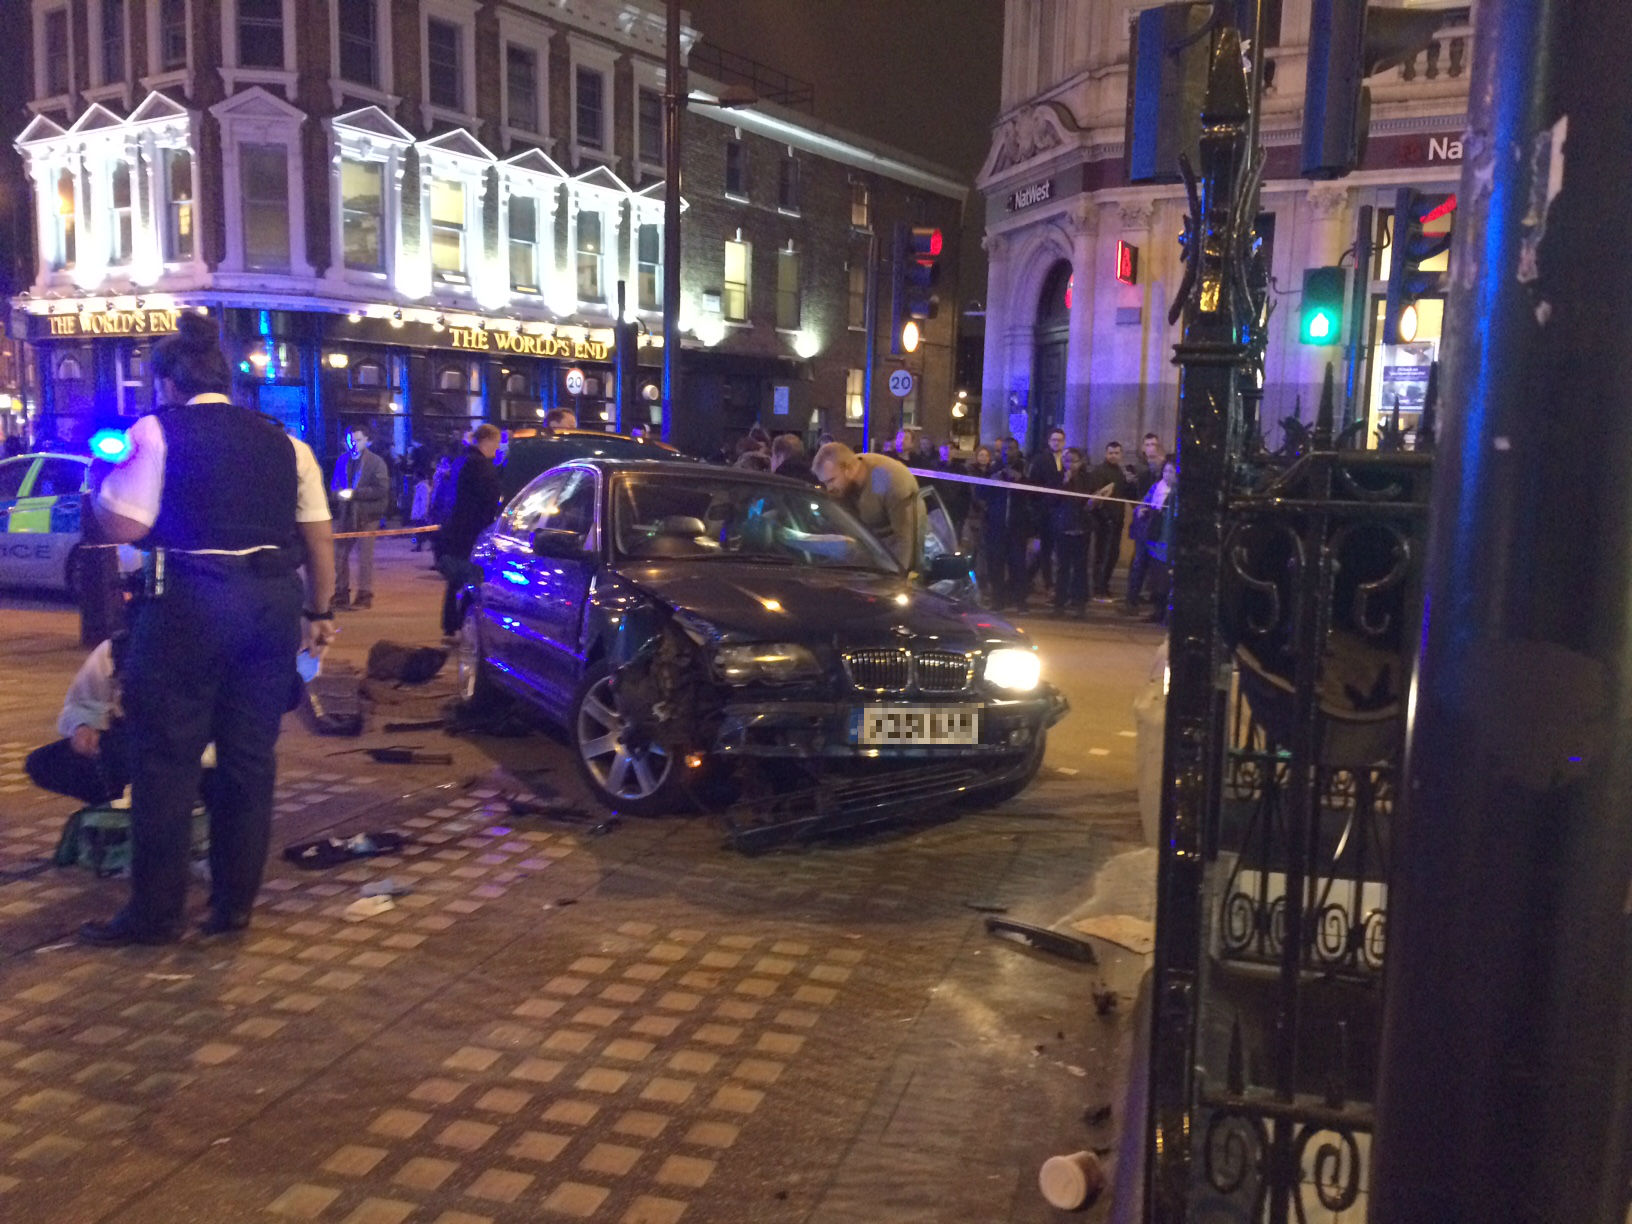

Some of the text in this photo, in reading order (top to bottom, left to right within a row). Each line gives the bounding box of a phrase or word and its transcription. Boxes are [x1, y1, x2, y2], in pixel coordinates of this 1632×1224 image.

[1015, 179, 1050, 210] NatWest
[48, 316, 76, 334] THE
[79, 312, 146, 334] WORLD'S
[449, 327, 609, 360] THE WORLD'S END
[568, 376, 582, 388] 20
[891, 376, 911, 389] 20
